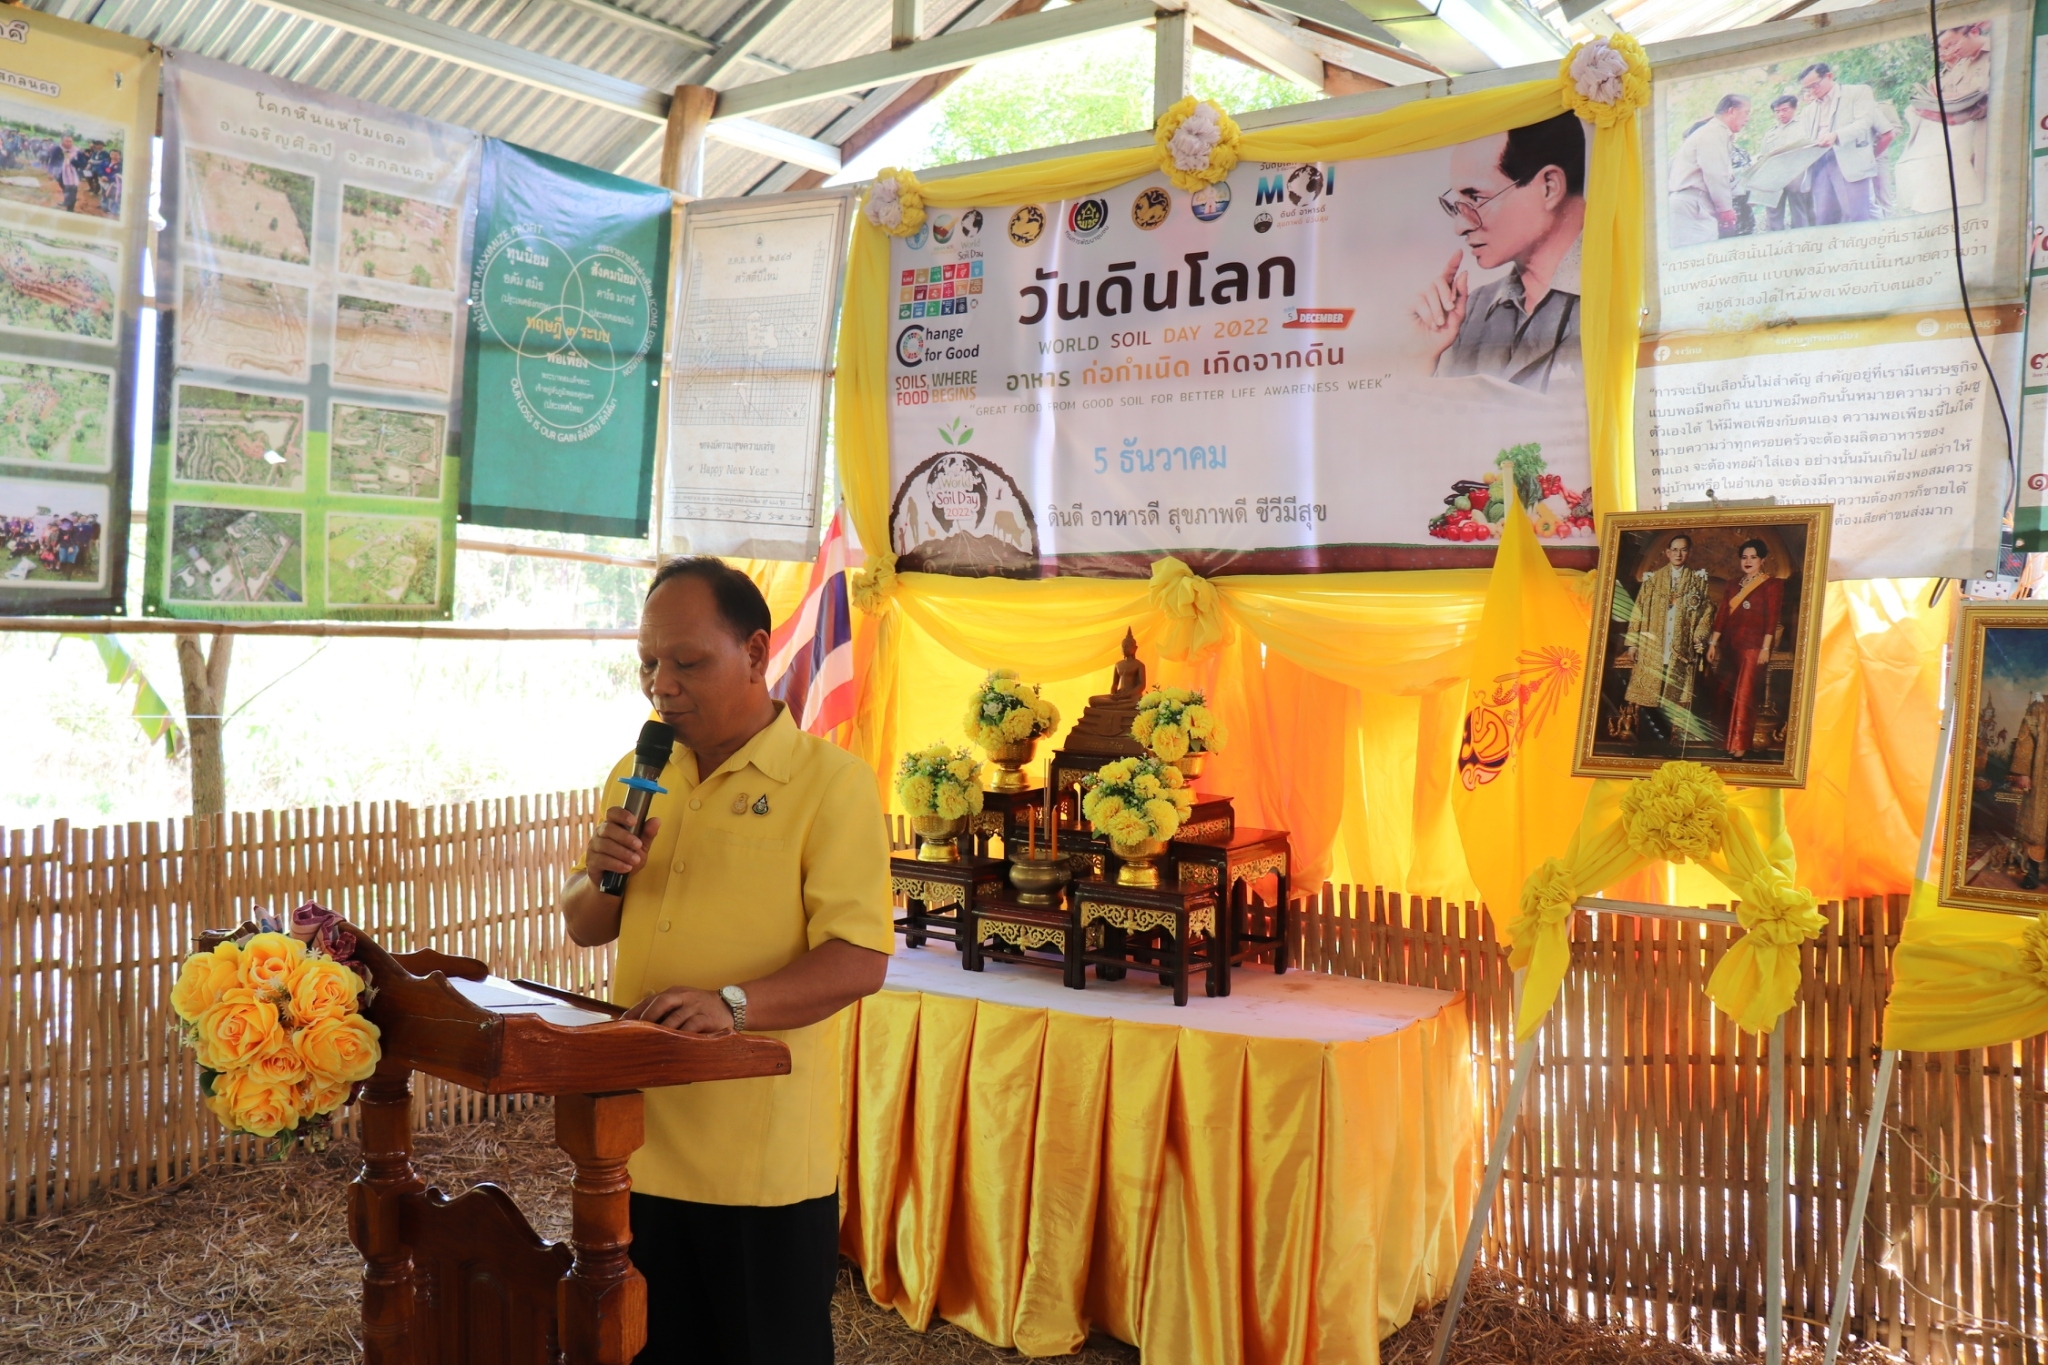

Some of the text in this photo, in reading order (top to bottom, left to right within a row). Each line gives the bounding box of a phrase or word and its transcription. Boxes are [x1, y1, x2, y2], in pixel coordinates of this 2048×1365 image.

[477, 223, 544, 278] MAXIMIZE PROFIT
[506, 246, 550, 268] ทุนนิยม
[591, 260, 638, 286] สังคมนิยม
[1663, 270, 1758, 296] แบบพอมีพอกิน
[1018, 251, 1296, 325] วันดินโลก
[526, 315, 563, 340] ทฤษฎี
[579, 325, 611, 344] ระบบ
[1299, 312, 1344, 324] DECEMBER
[1038, 317, 1269, 355] WORLD SOIL DAY 2022
[546, 351, 589, 369] พอเพียง
[622, 329, 656, 378] DISTRIBUTION
[925, 344, 980, 362] for Good
[932, 370, 977, 387] WHERE
[1006, 342, 1344, 391] อาหาร ก่อกำเนิด เกิดจากดิน
[896, 386, 977, 406] FOOD BEGINS
[1013, 403, 1042, 414] FOOD
[1047, 401, 1076, 412] FROM
[1082, 397, 1113, 410] GOOD
[1120, 396, 1145, 407] SOIL
[1151, 393, 1174, 404] FOR
[1180, 390, 1225, 402] BETTER
[1231, 387, 1256, 399] LIFE
[1264, 382, 1339, 396] AWARENESS
[1649, 398, 1741, 418] แบบพอมีพอกิน
[1955, 380, 1981, 396] อุ้มชู
[510, 377, 578, 443] OUR LOSS IS OUR GAIN
[1649, 420, 1702, 438] ตัวเองได้
[1094, 437, 1227, 475] 5 ธันวาคม
[699, 463, 770, 478] Happy New Year
[941, 473, 971, 489] World
[1651, 464, 1690, 477] ตนเอง
[936, 490, 979, 509] Soil Day
[946, 507, 970, 517] 2022
[1048, 496, 1328, 534] ดินดี อาหารดี สุขภาพดี ชีวีมีสุข
